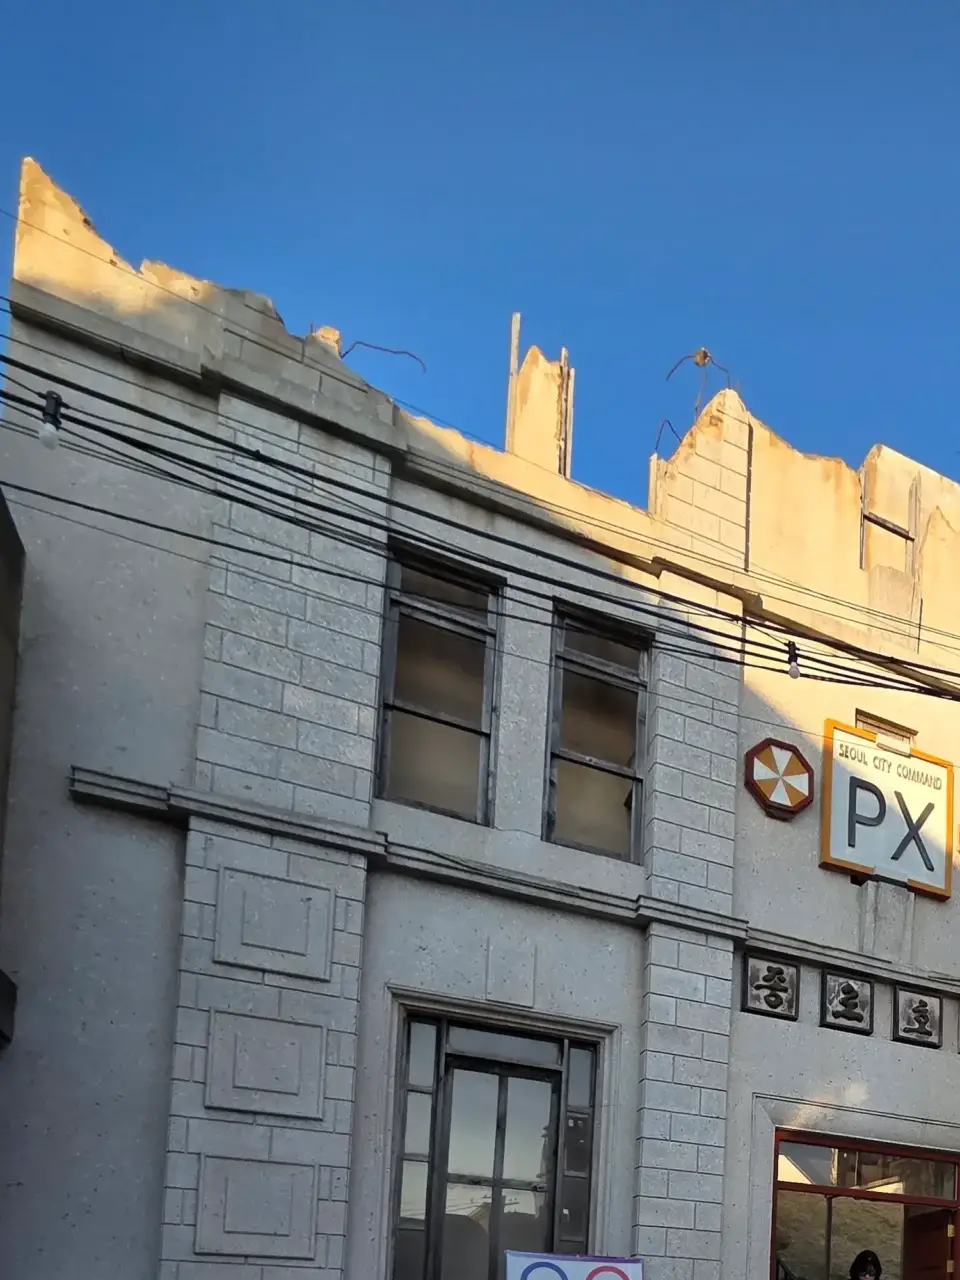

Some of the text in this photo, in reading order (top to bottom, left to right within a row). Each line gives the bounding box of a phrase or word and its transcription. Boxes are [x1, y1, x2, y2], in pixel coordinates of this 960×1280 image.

[839, 743, 942, 790] SEOUL CITY COMMAND
[847, 775, 935, 872] PX
